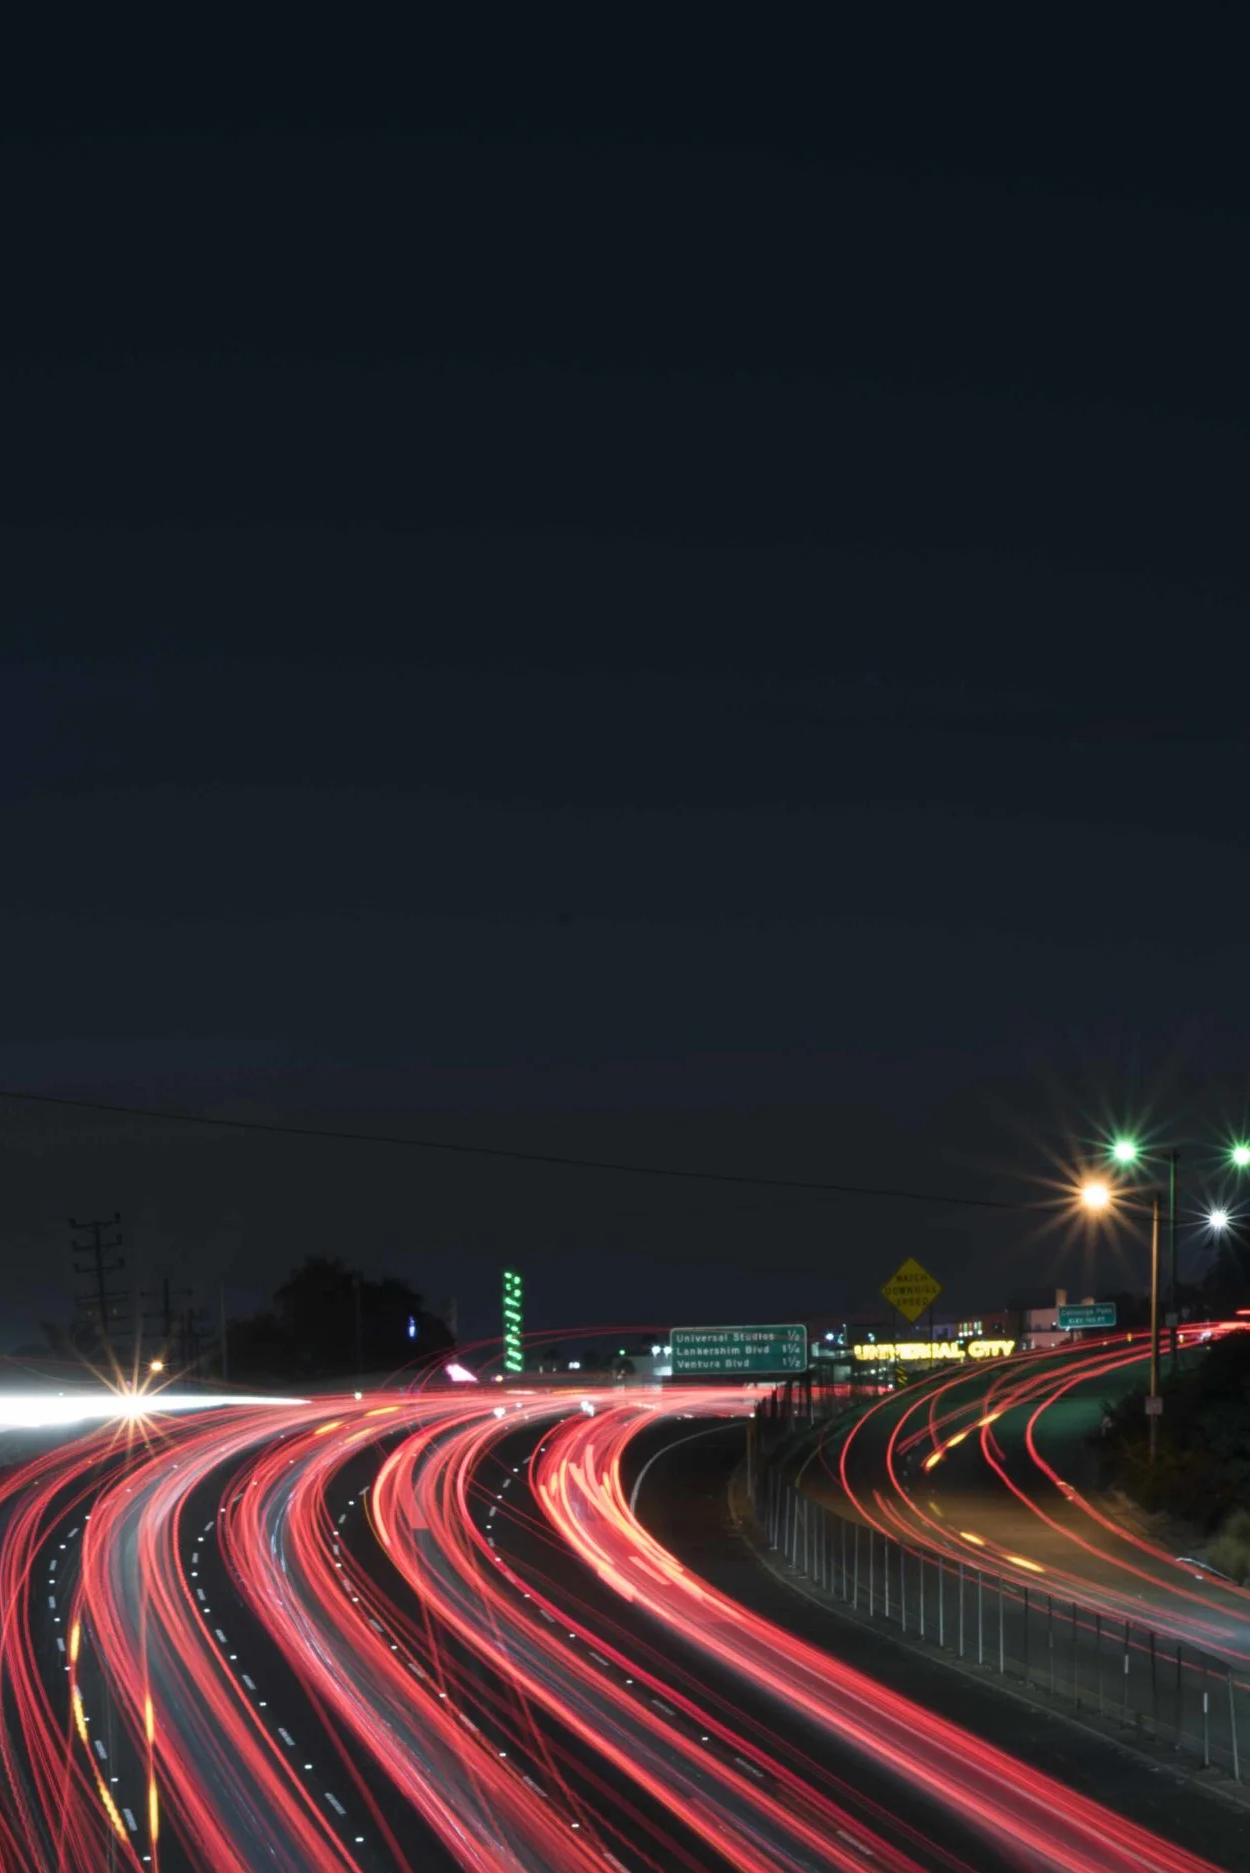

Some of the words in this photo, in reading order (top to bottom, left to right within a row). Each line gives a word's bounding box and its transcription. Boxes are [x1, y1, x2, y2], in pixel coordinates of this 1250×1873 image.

[676, 1333, 728, 1343] Universal
[733, 1332, 775, 1342] Studios
[676, 1346, 740, 1356] Lankershim
[745, 1345, 770, 1354] Blvd
[968, 1340, 1014, 1358] CITY
[677, 1360, 720, 1369] Ventura
[725, 1359, 750, 1368] Blvd
